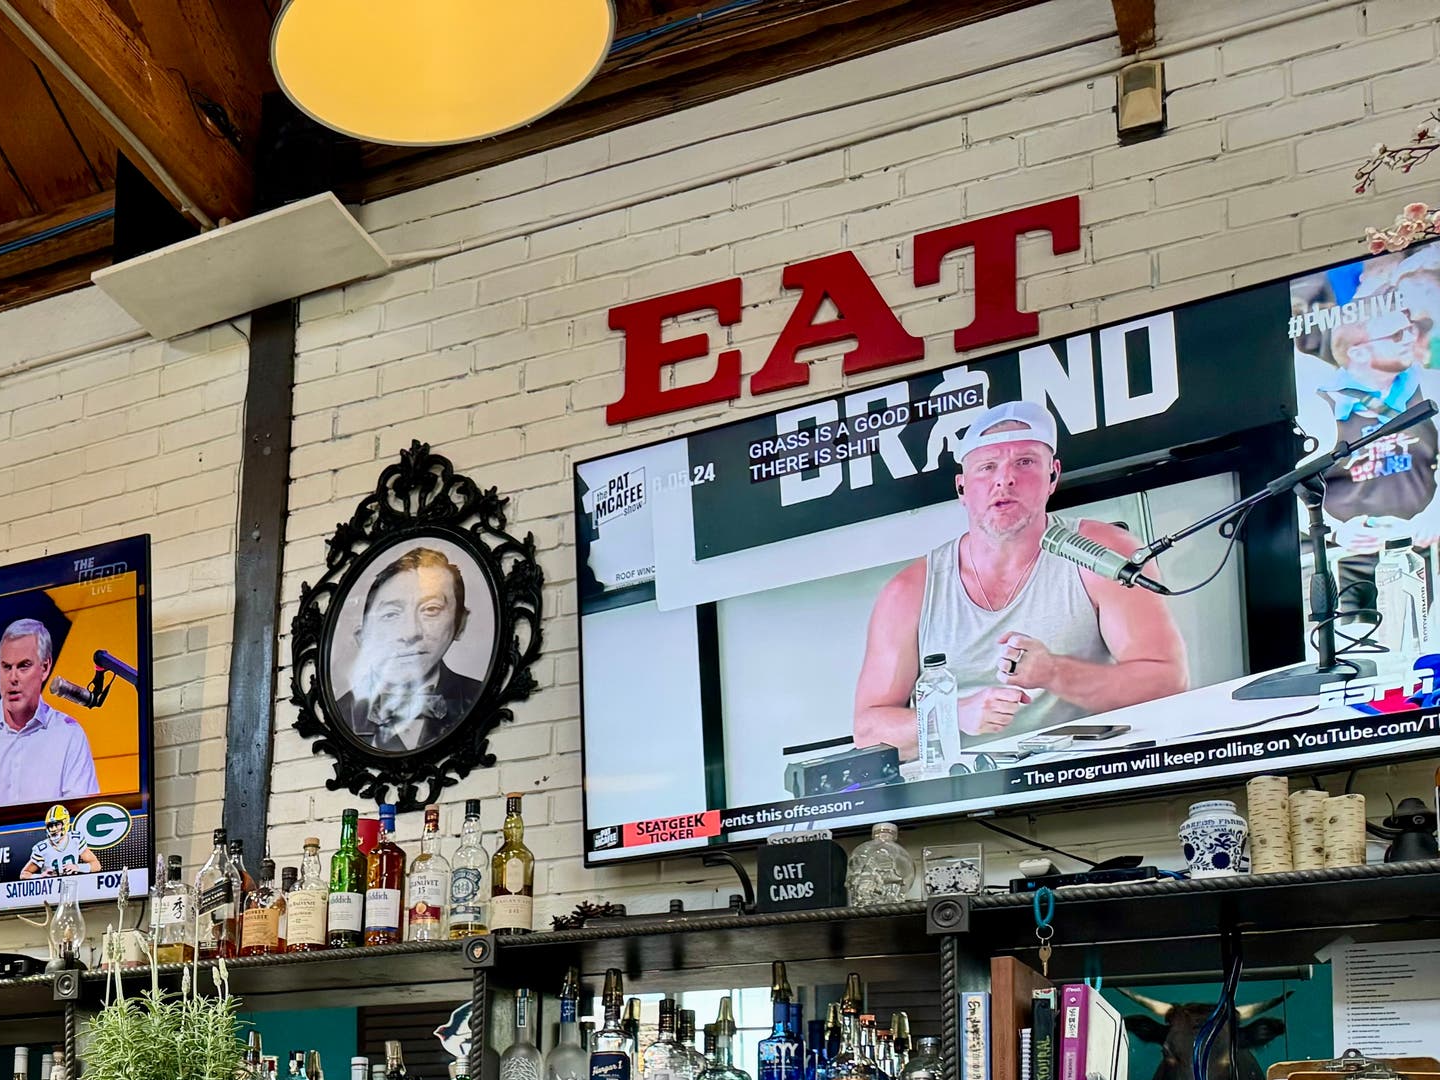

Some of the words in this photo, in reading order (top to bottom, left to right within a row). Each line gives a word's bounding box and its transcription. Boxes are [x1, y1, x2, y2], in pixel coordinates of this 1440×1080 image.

[606, 196, 1080, 425] EAT
[749, 431, 810, 460] GRASS
[815, 426, 832, 443] IS
[836, 421, 850, 439] A
[854, 406, 910, 432] GOOD
[915, 388, 984, 419] THING.
[750, 456, 810, 481] THERE
[814, 451, 831, 466] IS
[836, 435, 879, 460] SHIT
[608, 472, 630, 496] PAT
[595, 483, 643, 519] MCAFEE
[623, 502, 643, 516] show
[74, 557, 95, 572] THE
[91, 584, 113, 595] LIVE
[1024, 770, 1055, 787] The
[1058, 761, 1128, 786] progrum
[1130, 752, 1161, 771] will
[1164, 746, 1205, 767] keep
[1208, 739, 1265, 764] rolling
[1267, 738, 1291, 752] on
[756, 808, 782, 823] this
[784, 801, 852, 819] offseason
[636, 812, 706, 836] SEATGEEK
[649, 828, 695, 844] TICKER
[96, 873, 123, 890] FOX
[773, 862, 806, 880] GIFT
[6, 880, 52, 900] SATURDAY
[769, 881, 815, 902] CARDS
